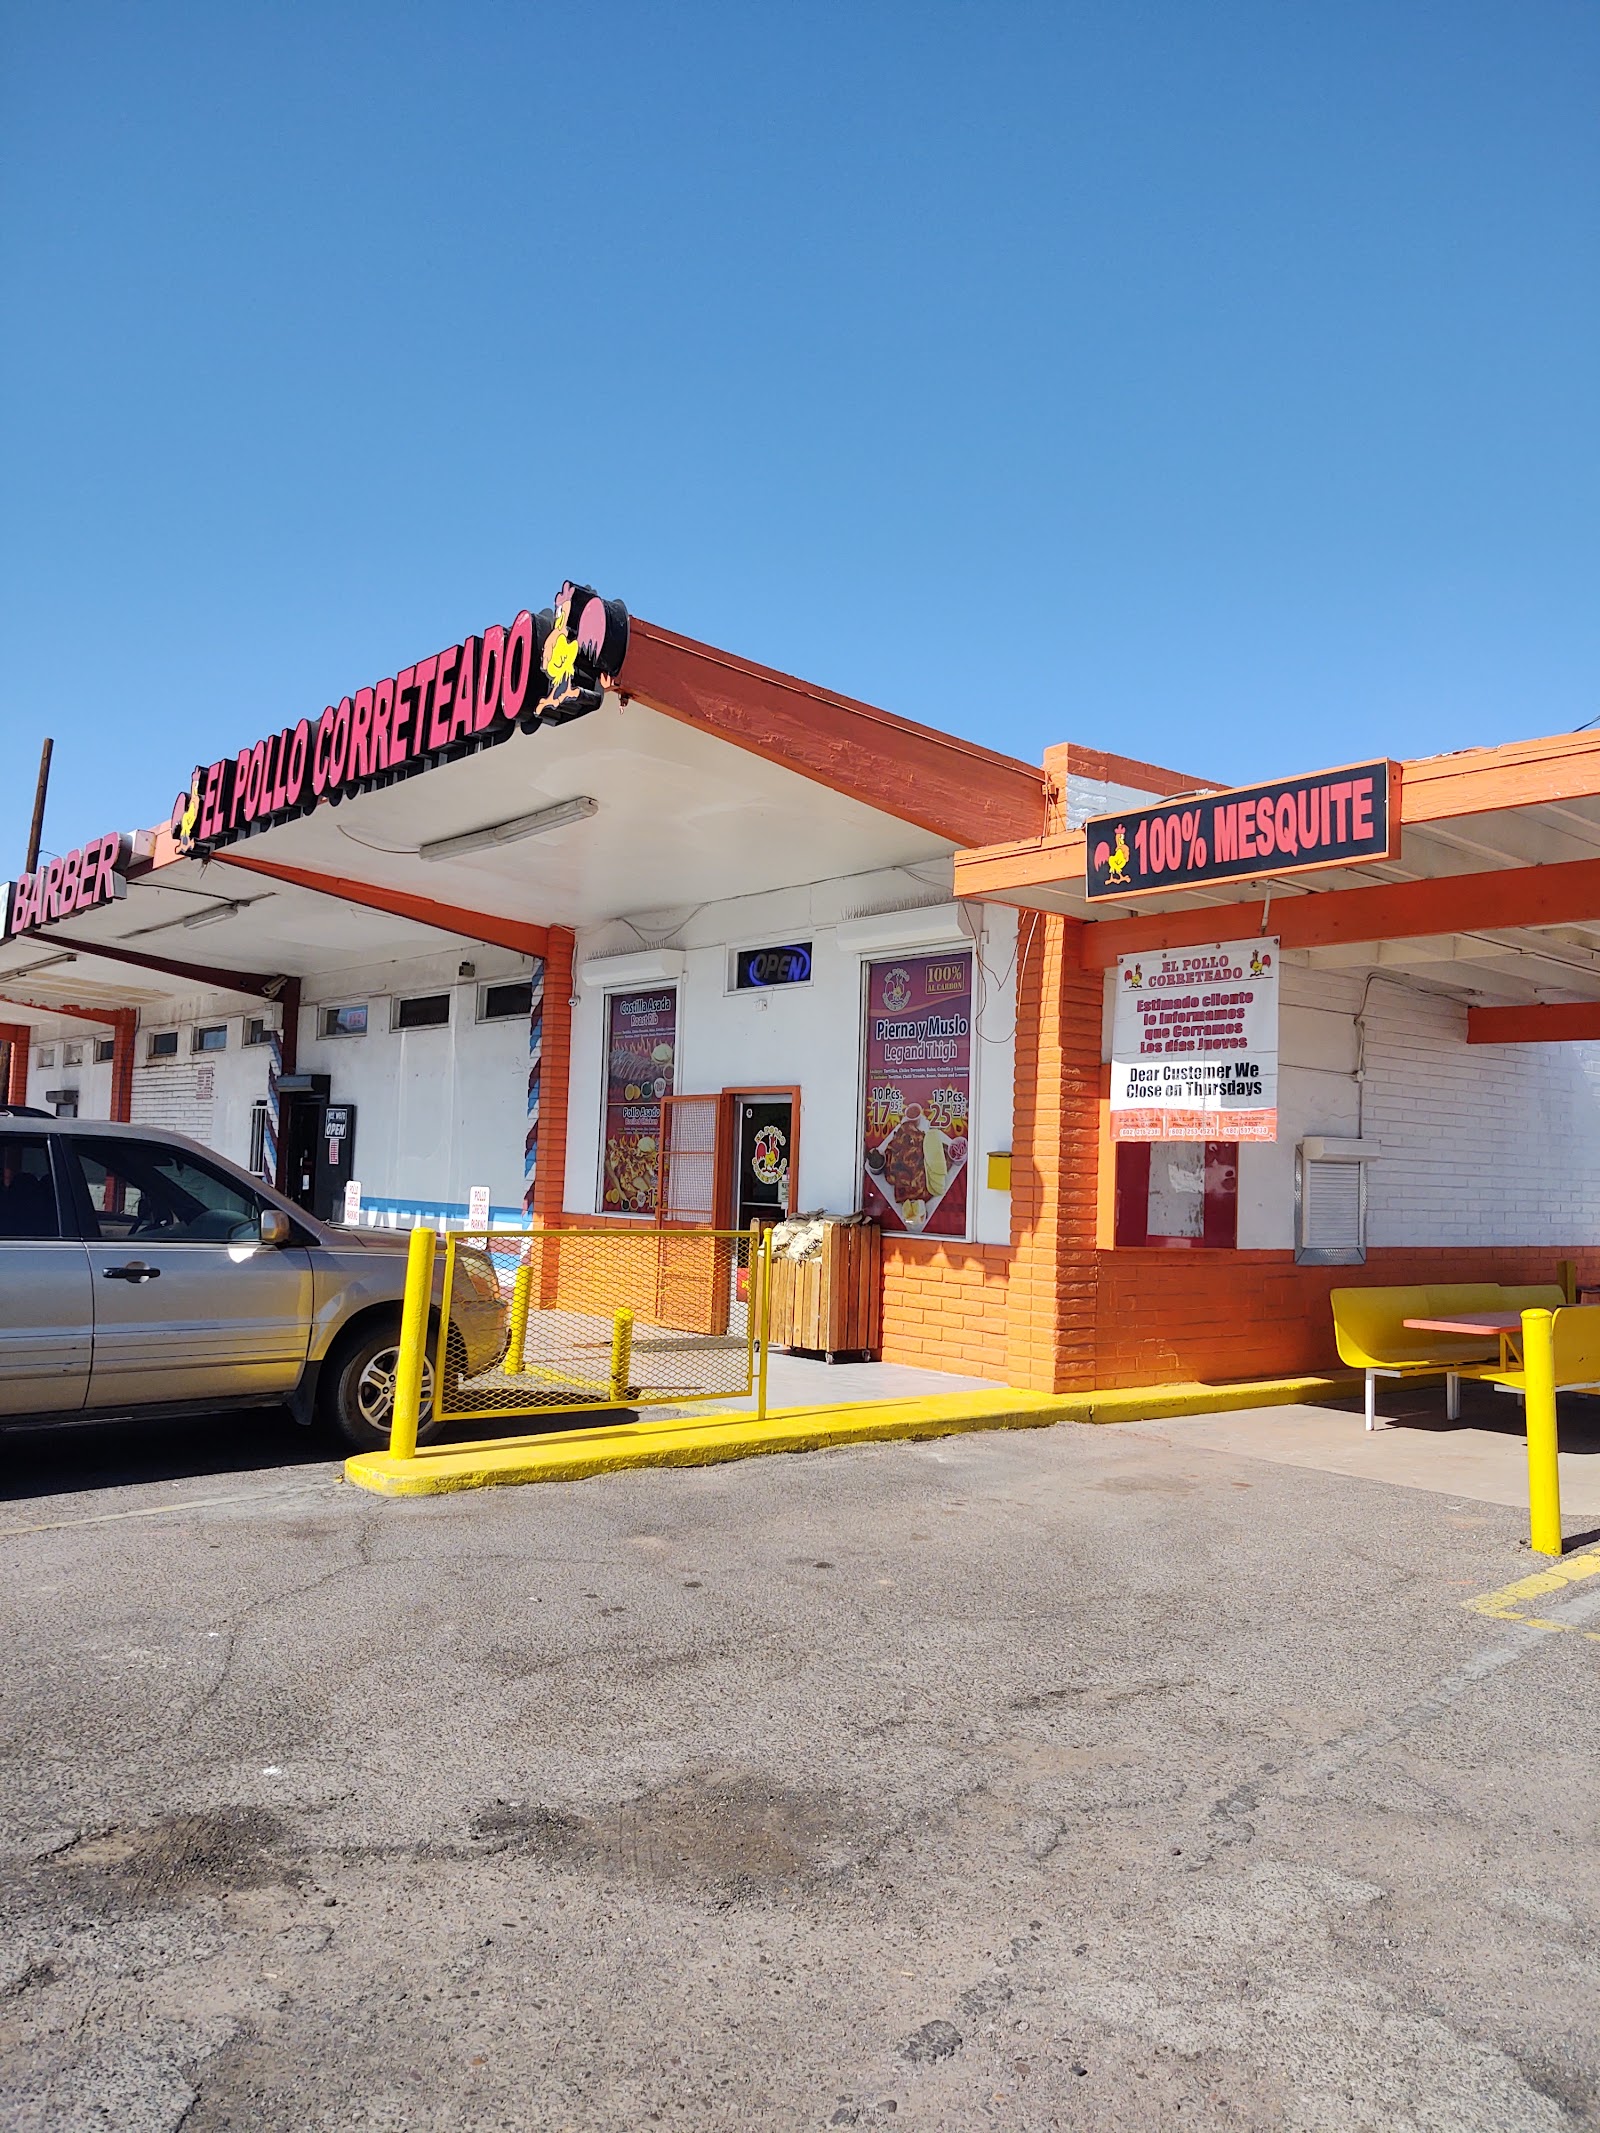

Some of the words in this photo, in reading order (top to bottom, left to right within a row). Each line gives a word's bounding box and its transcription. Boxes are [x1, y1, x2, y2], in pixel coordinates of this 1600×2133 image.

[199, 758, 228, 841] EL
[229, 718, 309, 829] POLLO
[312, 609, 533, 796] CORRETEADO
[1134, 808, 1207, 875] 100%
[1214, 777, 1374, 864] MESQUITE
[11, 831, 120, 934] BARBER
[754, 953, 804, 981] OPEN
[928, 965, 962, 983] 100%
[1161, 961, 1179, 974] EL
[1182, 955, 1229, 971] POLLO
[928, 984, 936, 992] AL
[937, 982, 962, 991] CARBON
[1148, 967, 1243, 988] CORRETEADO
[620, 998, 647, 1015] Costilla
[648, 996, 671, 1012] Asada
[1136, 995, 1200, 1013] Estimado
[876, 1017, 916, 1040] Pierna
[918, 1021, 927, 1043] y
[928, 1013, 968, 1037] Muslo
[1143, 1013, 1157, 1026] le
[1144, 1028, 1170, 1041] que
[1172, 1022, 1243, 1038] Cerramos
[885, 1044, 903, 1065] Leg
[904, 1041, 925, 1060] and
[926, 1040, 957, 1063] Thigh
[1140, 1041, 1162, 1053] Los
[1198, 1036, 1248, 1051] Jueves
[1130, 1067, 1160, 1083] Dear
[1163, 1064, 1232, 1081] Customer
[1235, 1062, 1259, 1078] We
[872, 1087, 884, 1100] 10
[885, 1088, 903, 1100] Pcs.
[932, 1090, 944, 1102] 15
[947, 1090, 966, 1102] Pcs.
[1126, 1083, 1162, 1098] Close
[1165, 1084, 1182, 1097] on
[1186, 1080, 1262, 1097] Thursdays
[623, 1106, 640, 1118] Pollo
[640, 1105, 661, 1117] Asado
[326, 1122, 346, 1137] OPEN
